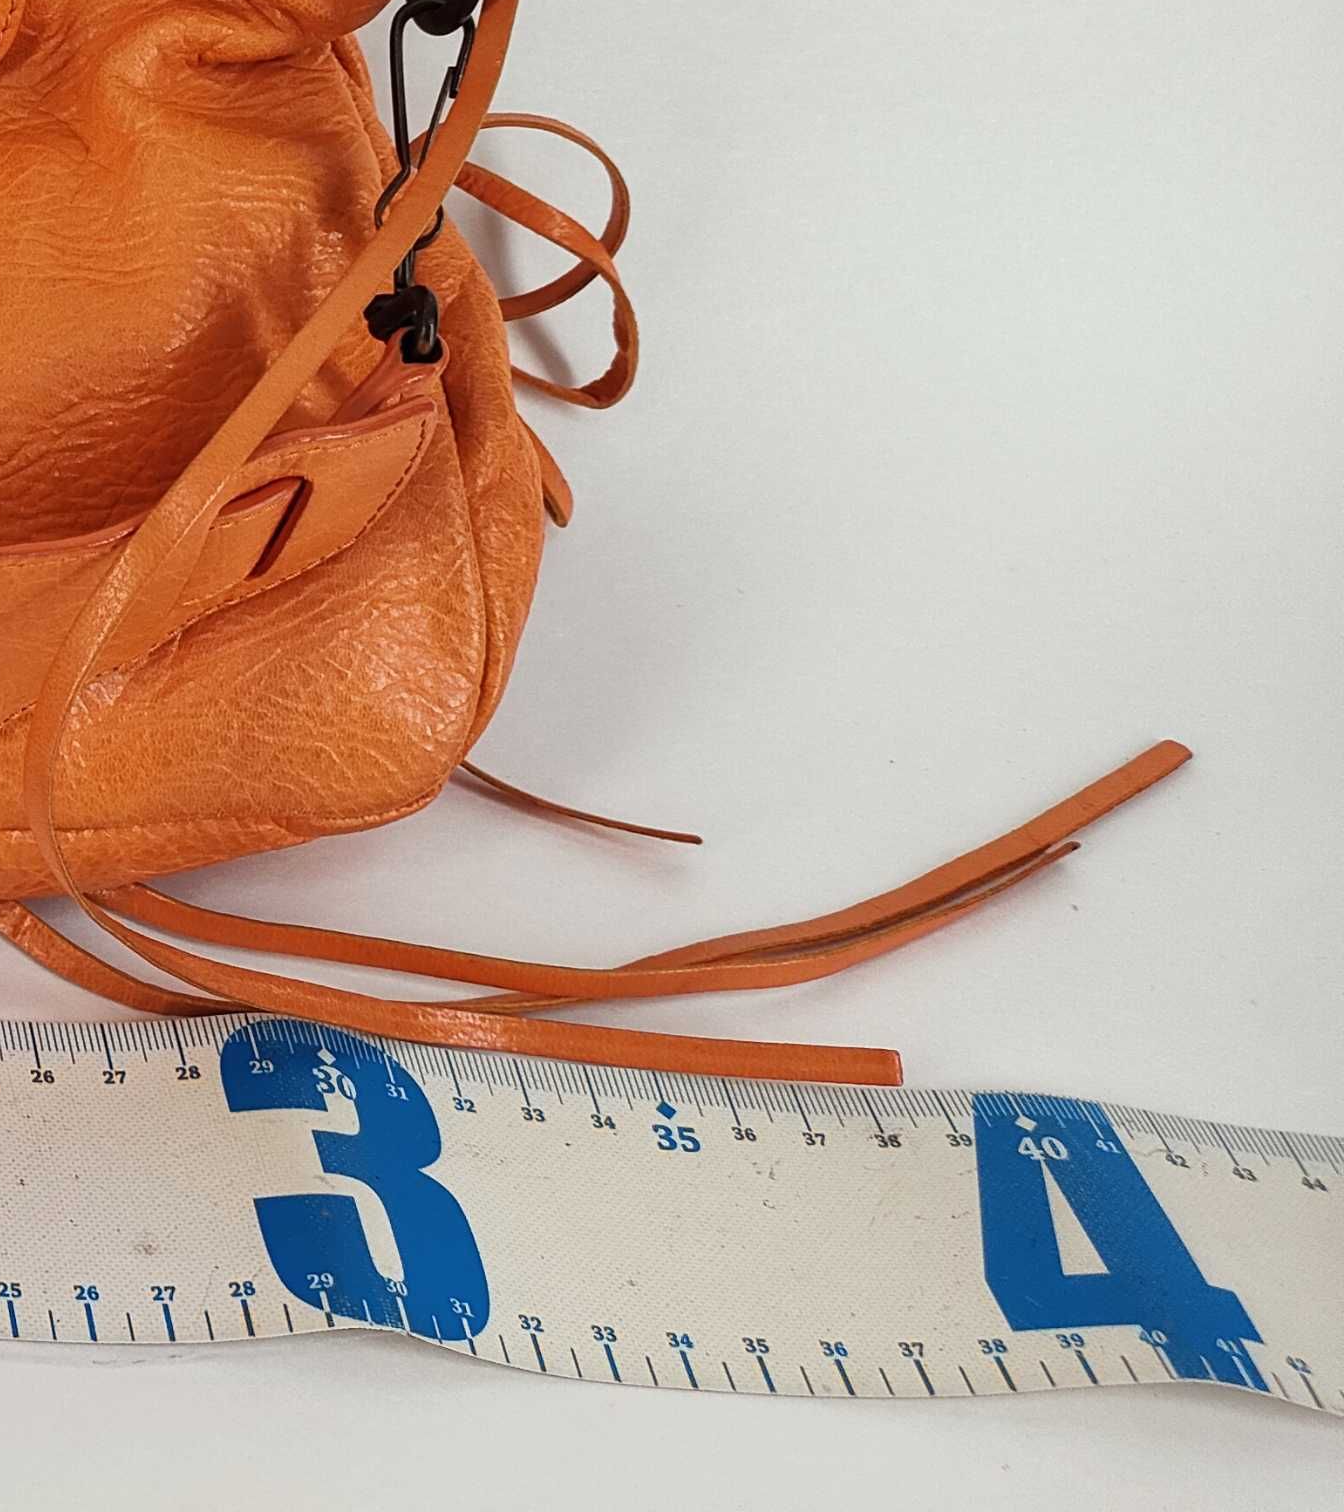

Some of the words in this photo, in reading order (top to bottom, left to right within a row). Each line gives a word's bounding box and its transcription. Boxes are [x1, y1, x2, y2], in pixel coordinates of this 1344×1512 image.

[30, 1070, 55, 1084] 26
[102, 1071, 127, 1085] 27
[175, 1066, 201, 1080] 28
[249, 1060, 274, 1074] 29
[312, 1065, 357, 1101] 30
[385, 1083, 409, 1101] 31
[452, 1097, 477, 1113] 32
[521, 1107, 546, 1123] 33
[590, 1114, 616, 1129] 34
[652, 1124, 701, 1153] 35
[731, 1126, 757, 1142] 36
[802, 1132, 826, 1146] 37
[873, 1133, 902, 1148] 38
[946, 1133, 973, 1147] 39
[1018, 1137, 1069, 1160] 40
[1096, 1139, 1121, 1153] 41
[1165, 1153, 1190, 1168] 42
[1233, 1167, 1258, 1182] 43
[1301, 1176, 1328, 1191] 44
[220, 1019, 490, 1341] 3
[972, 1090, 1272, 1393] 4
[73, 1285, 100, 1301] 26
[150, 1286, 177, 1302] 27
[229, 1281, 257, 1297] 28
[306, 1273, 334, 1289] 29
[385, 1277, 409, 1296] 30
[449, 1297, 475, 1316] 31
[518, 1314, 544, 1332] 32
[591, 1325, 618, 1343] 33
[666, 1332, 694, 1349] 34
[742, 1337, 770, 1354] 35
[819, 1339, 849, 1357] 36
[897, 1341, 925, 1357] 37
[977, 1338, 1008, 1356] 38
[1057, 1333, 1086, 1348] 39
[1139, 1329, 1168, 1346] 40
[1215, 1338, 1242, 1356] 41
[1286, 1354, 1313, 1375] 42
